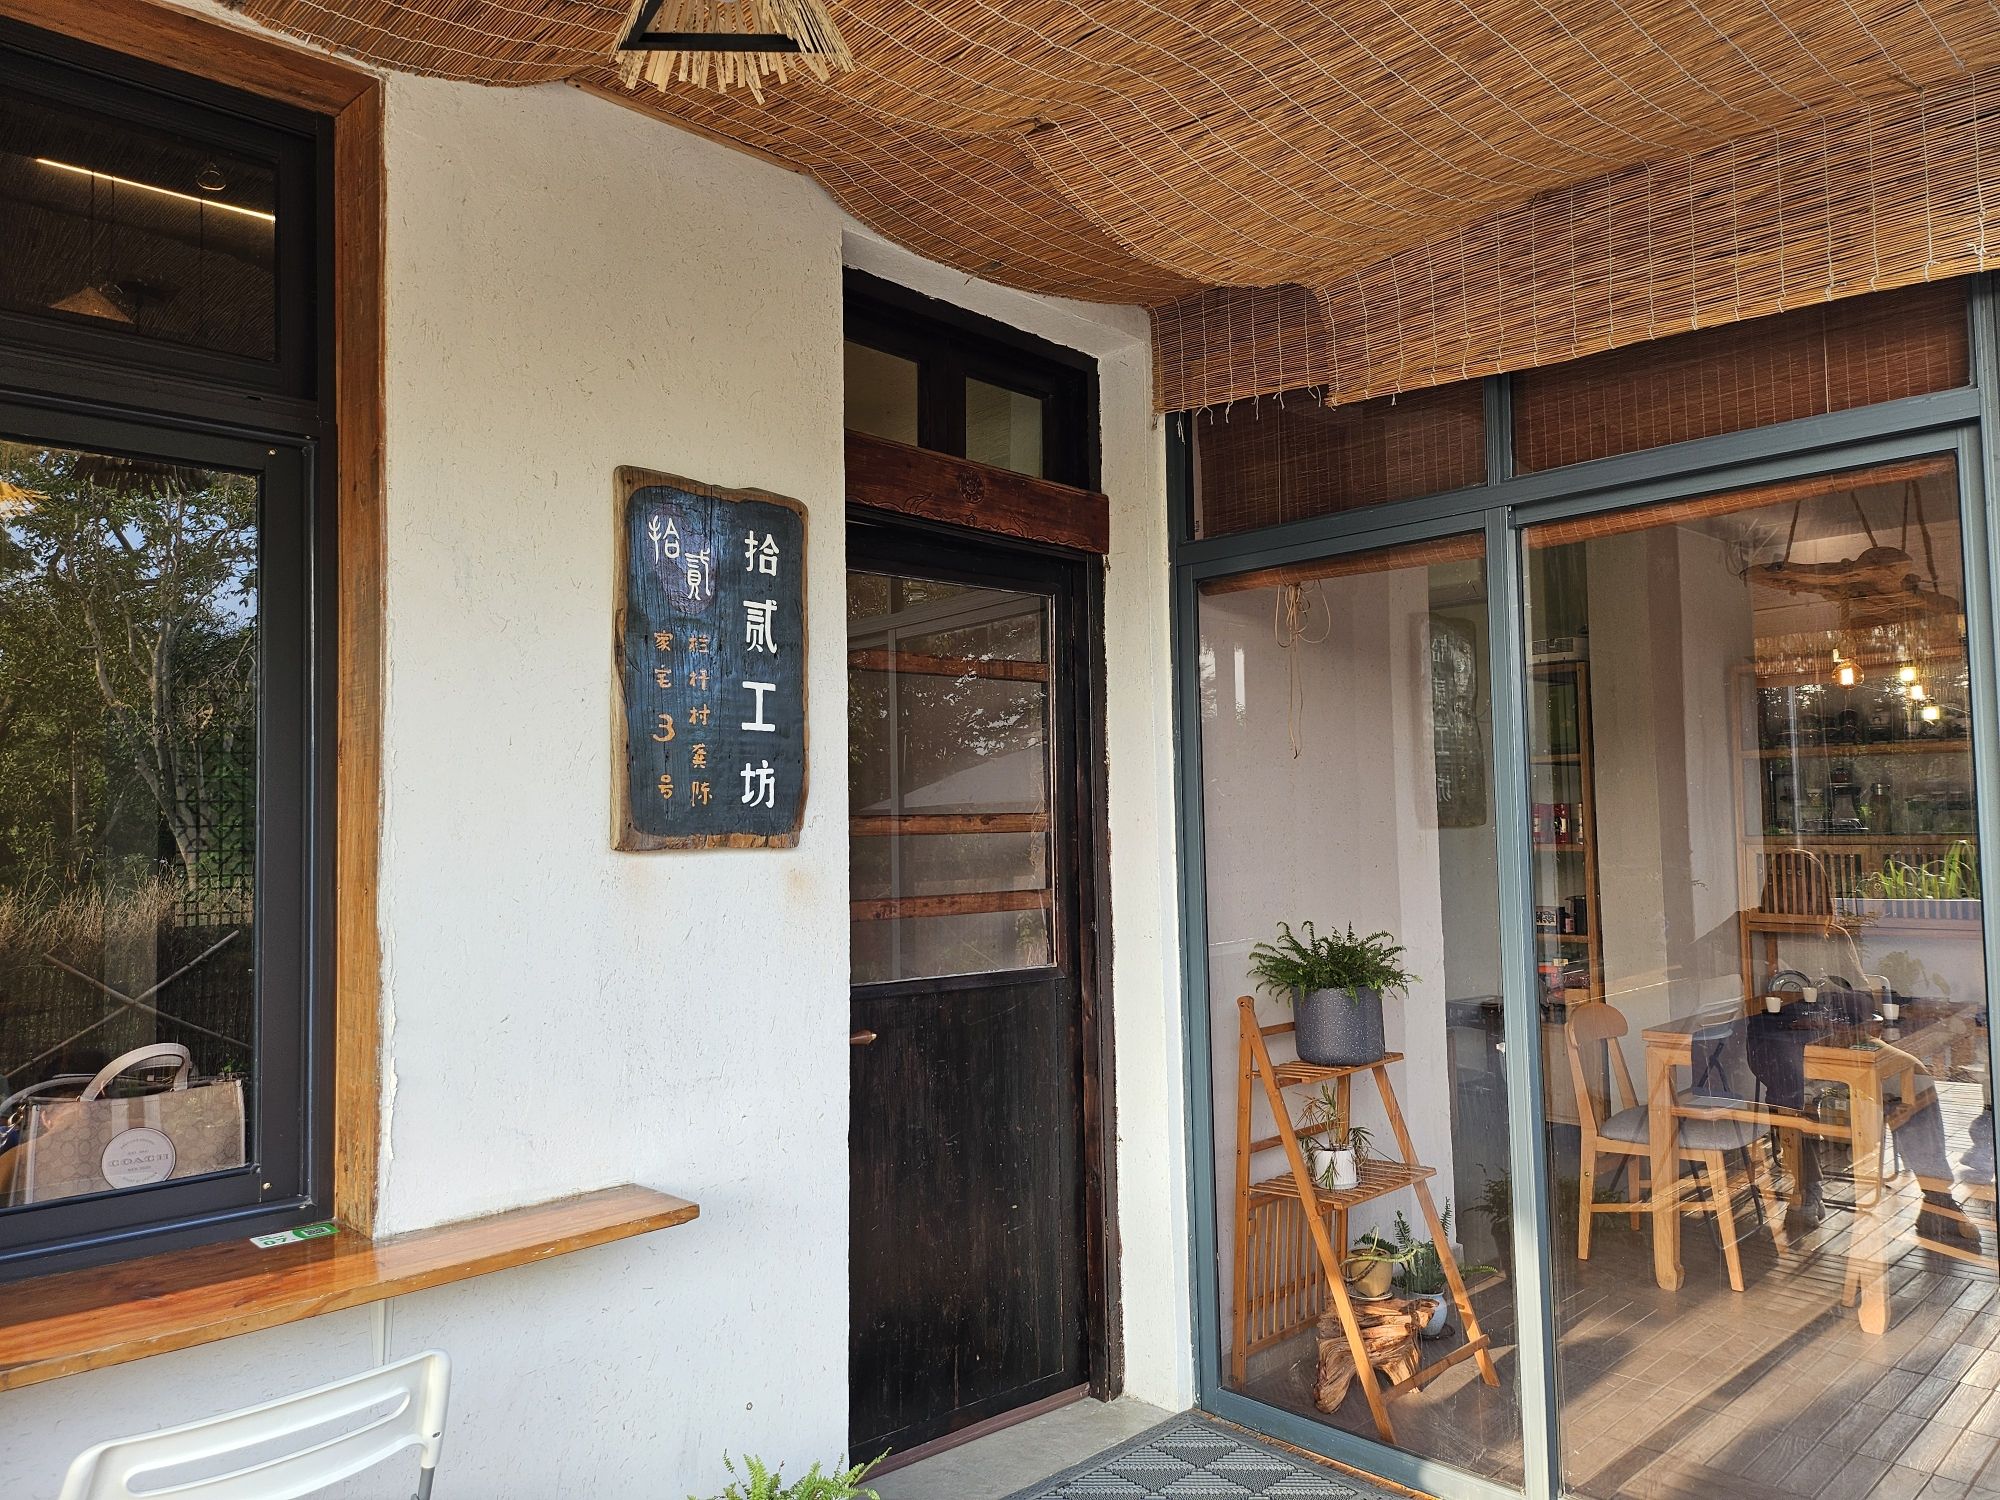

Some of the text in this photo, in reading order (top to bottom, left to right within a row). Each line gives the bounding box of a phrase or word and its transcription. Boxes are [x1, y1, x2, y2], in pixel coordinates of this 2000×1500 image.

[653, 630, 676, 800] 家宅3号
[740, 530, 779, 809] 拾贰工坊
[108, 1153, 169, 1168] COACH
